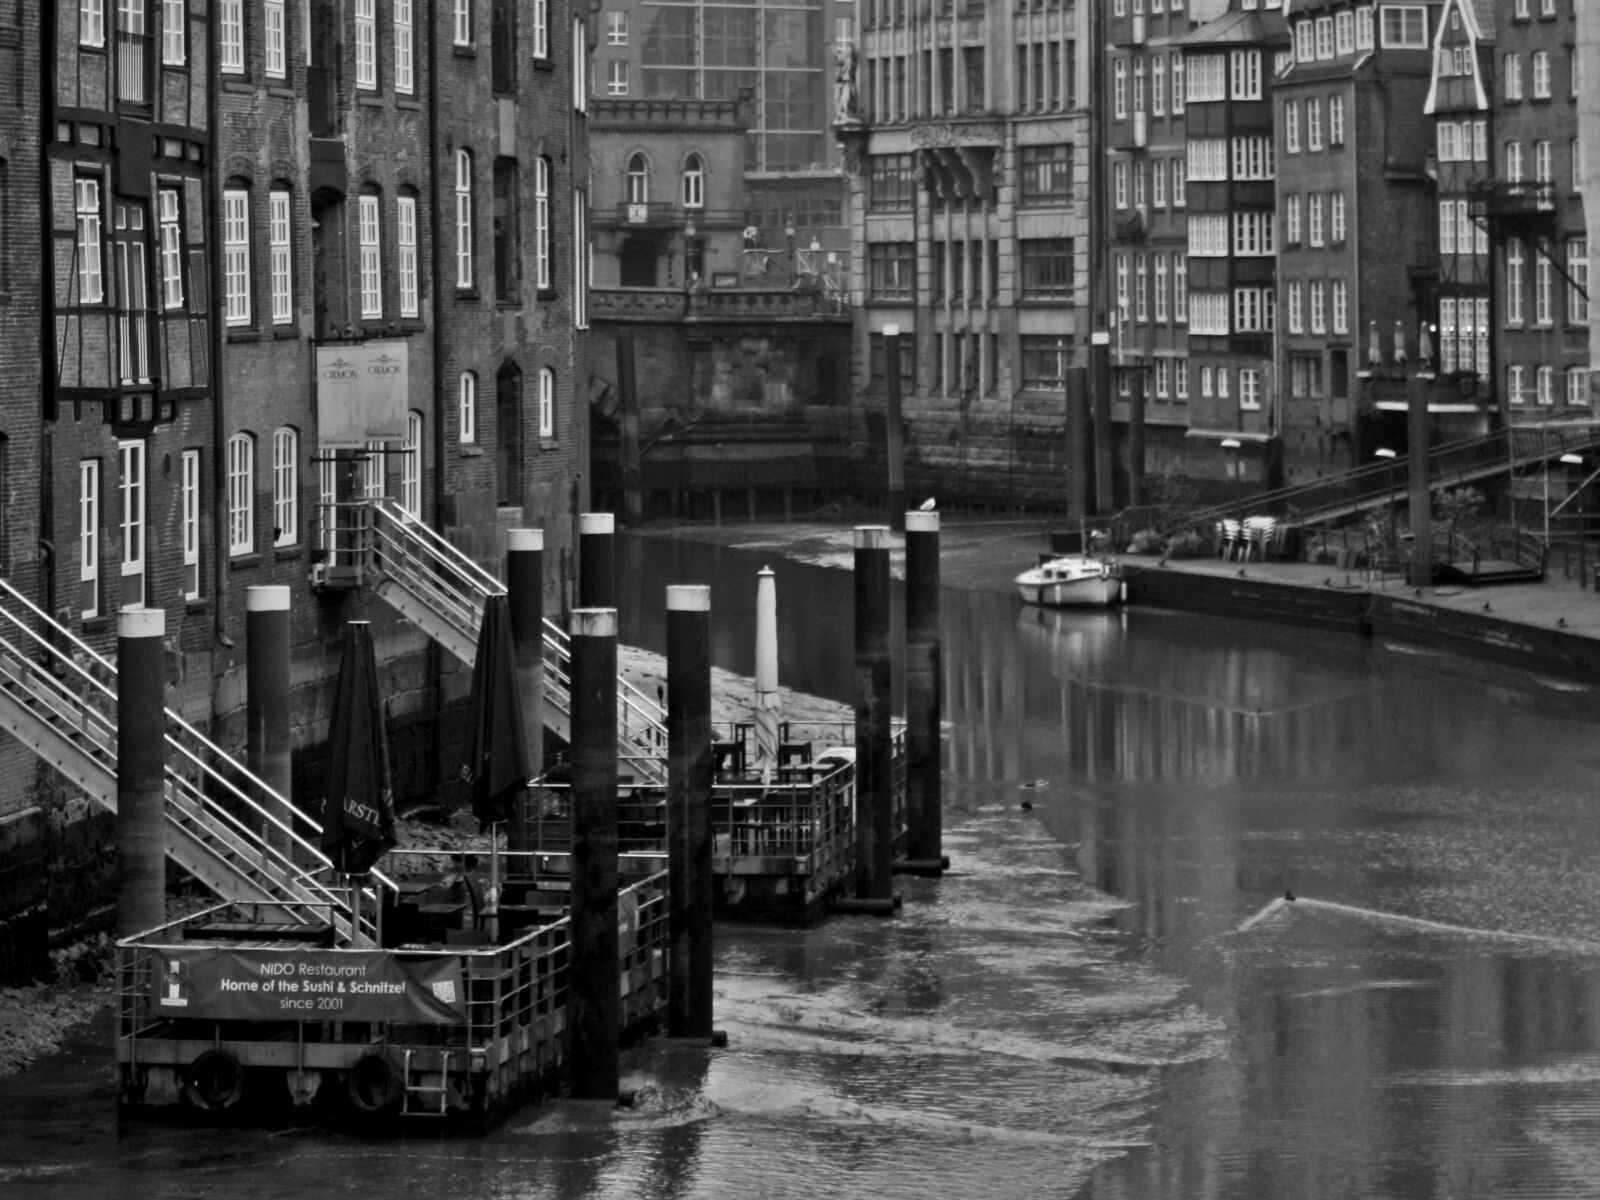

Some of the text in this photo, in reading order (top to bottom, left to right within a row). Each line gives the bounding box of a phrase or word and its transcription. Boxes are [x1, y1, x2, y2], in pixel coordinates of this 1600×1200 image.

[260, 963, 366, 977] NIDO Restaurant
[221, 979, 406, 994] Home of the Sushi & Schnitzel
[280, 997, 344, 1010] since 2001
